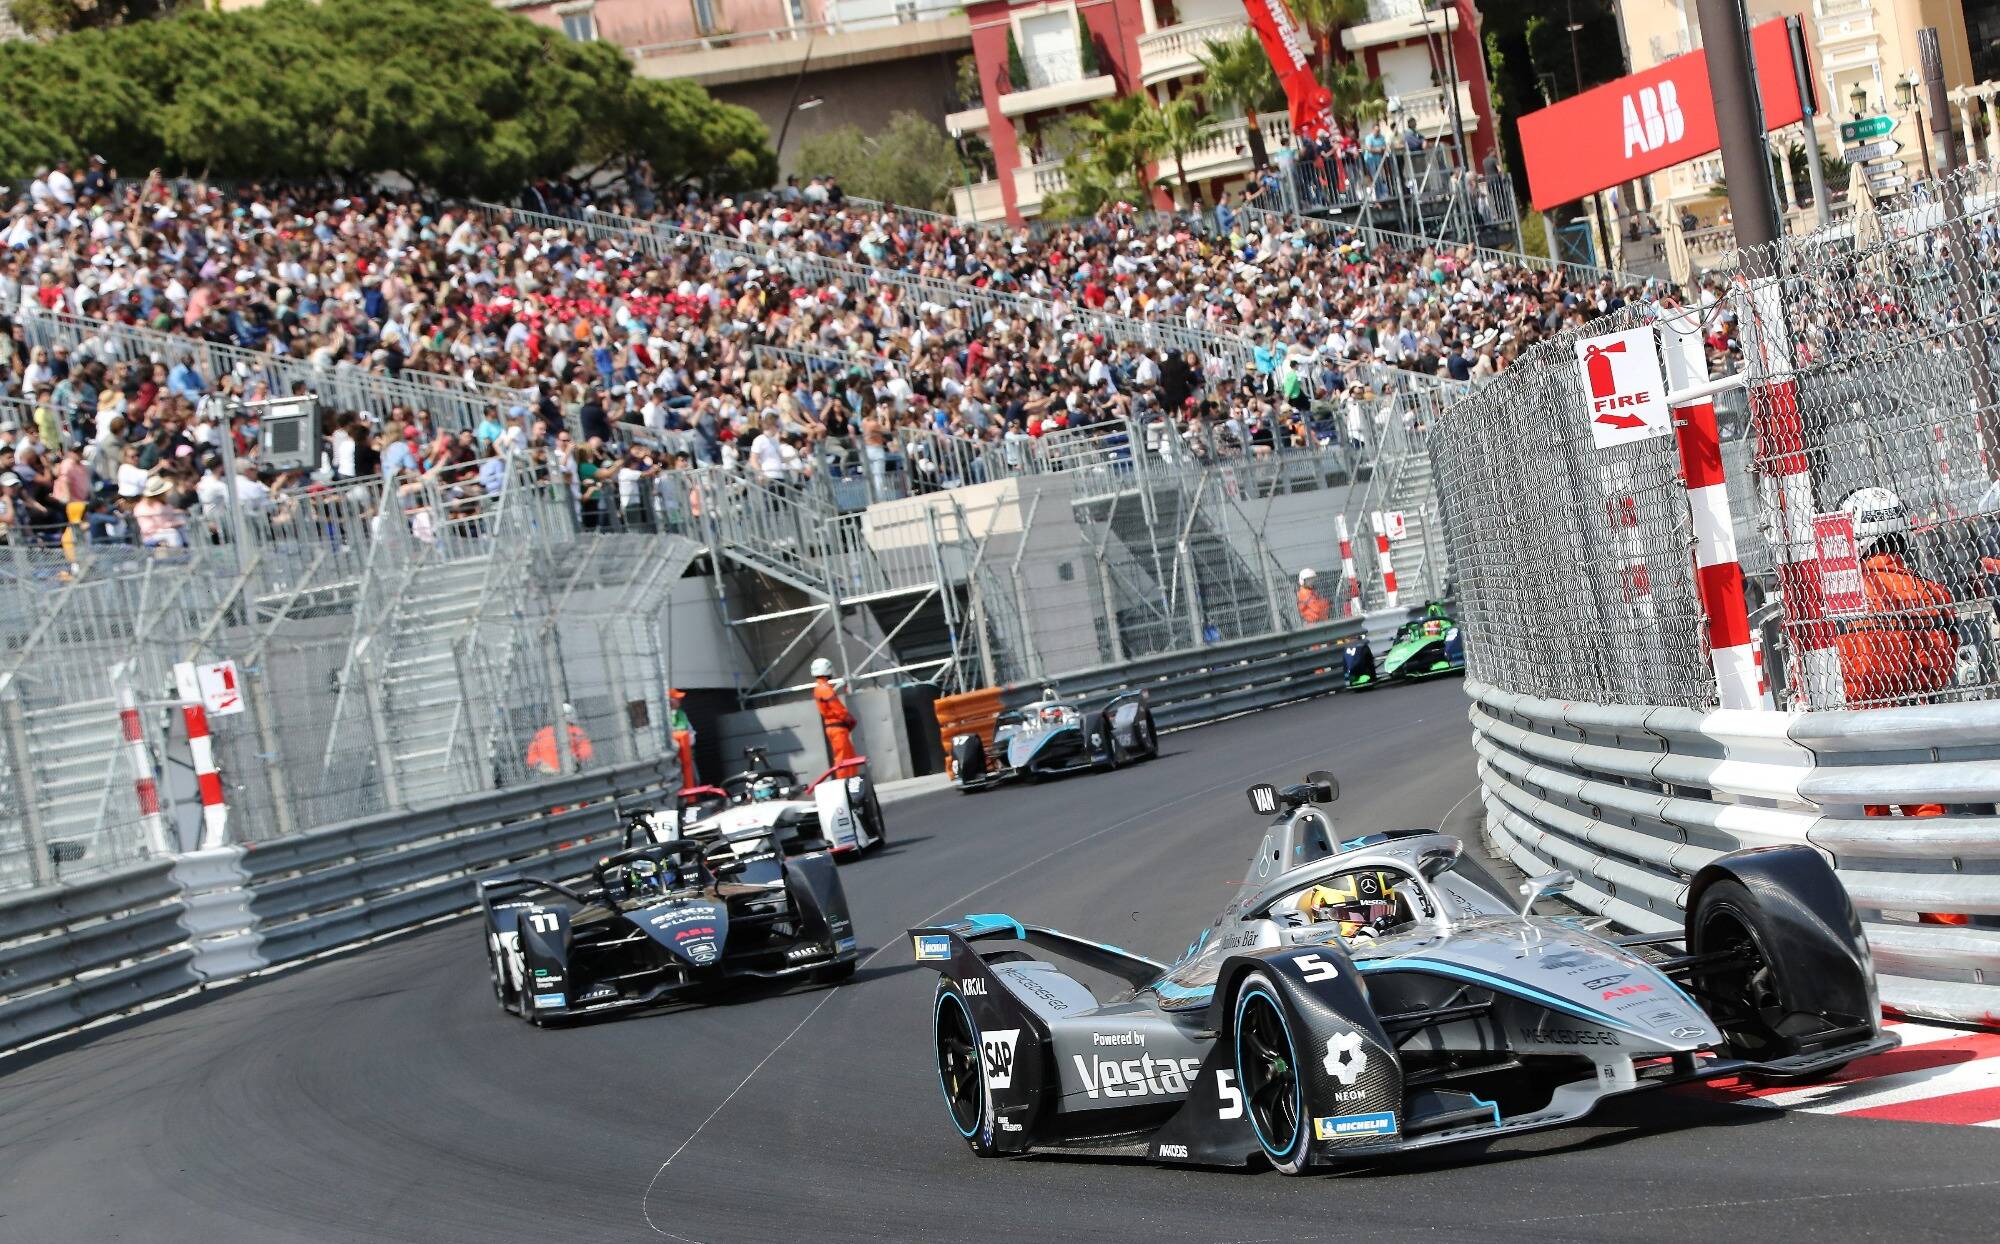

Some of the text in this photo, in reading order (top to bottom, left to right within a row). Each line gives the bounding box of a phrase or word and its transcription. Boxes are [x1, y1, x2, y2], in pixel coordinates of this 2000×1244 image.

[1622, 80, 1685, 159] ABB
[1594, 391, 1651, 413] FIRE
[1252, 787, 1276, 812] VAN
[529, 913, 560, 933] 11
[1242, 930, 1259, 947] Bär
[1293, 954, 1339, 983] 5
[1093, 1031, 1145, 1047] Powered by
[985, 1041, 1012, 1079] SAP
[1072, 1051, 1201, 1100] Vestas
[1215, 1068, 1243, 1120] 5
[1334, 1090, 1366, 1101] NEOM
[1336, 1118, 1389, 1132] MICHELIN
